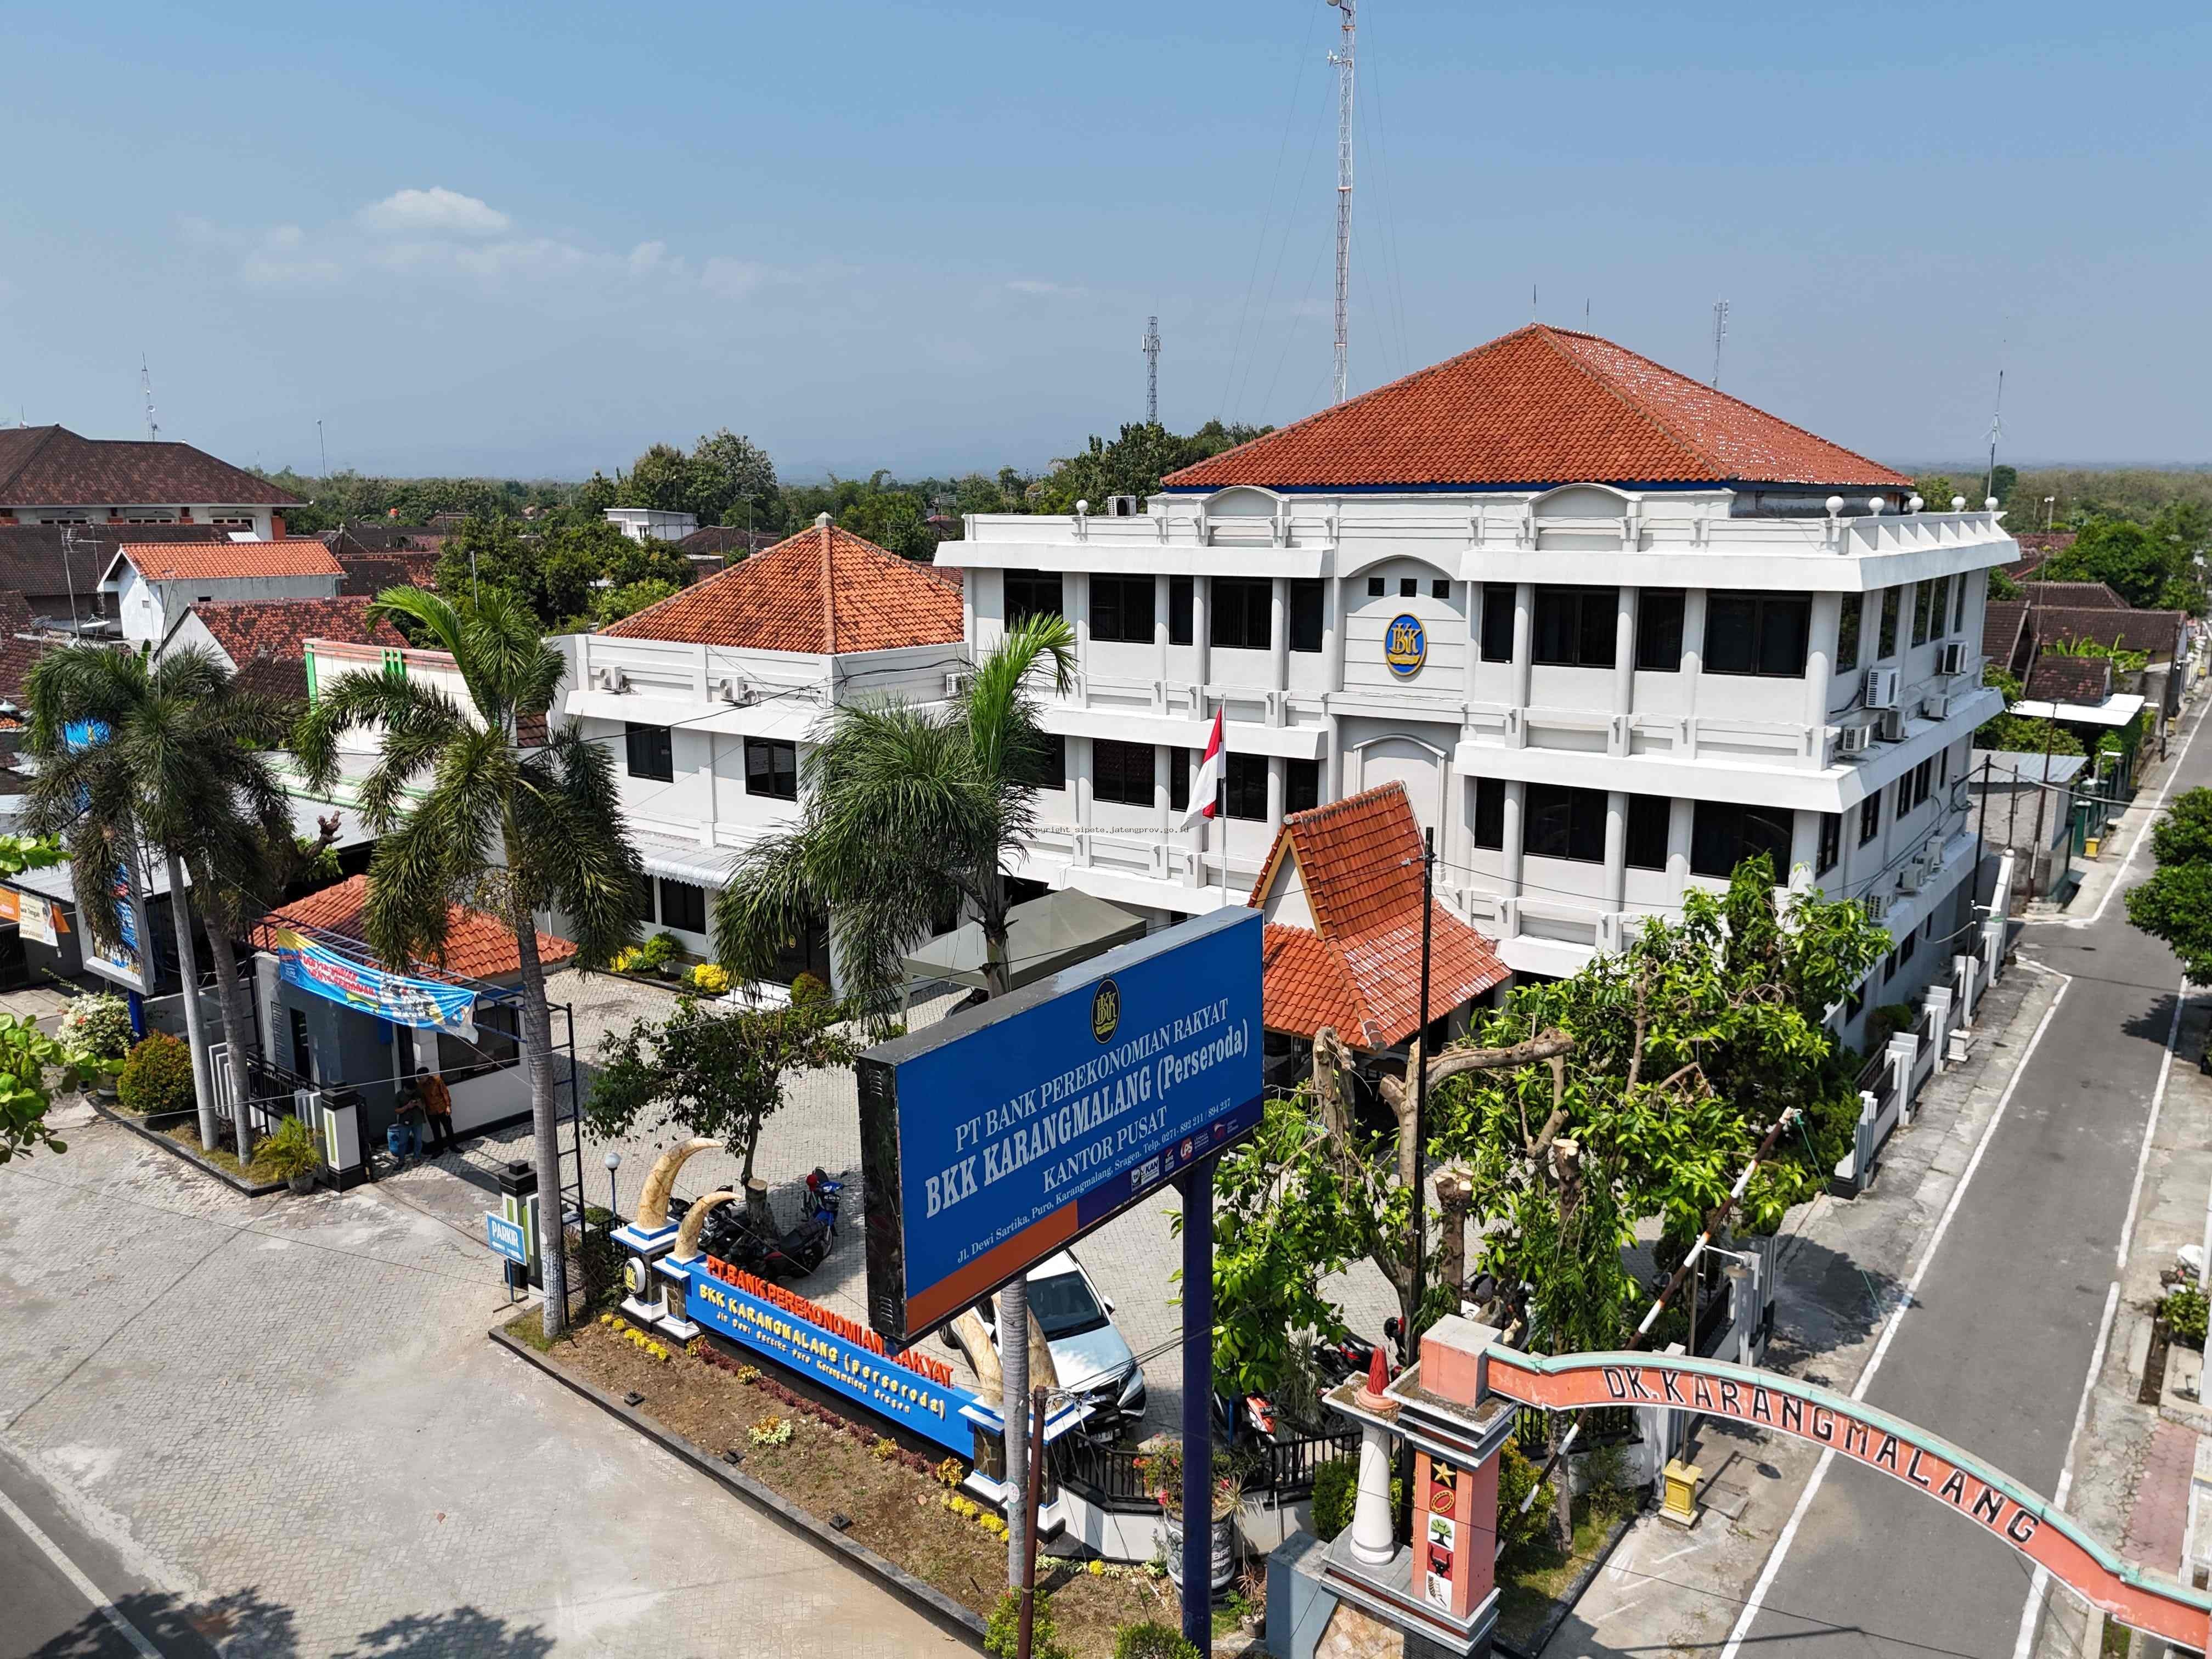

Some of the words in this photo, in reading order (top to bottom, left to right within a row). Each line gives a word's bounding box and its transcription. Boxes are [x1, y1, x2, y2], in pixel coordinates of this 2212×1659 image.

[955, 1116, 981, 1153] PT
[985, 1088, 1037, 1137] BANK
[1040, 1024, 1171, 1109] PEREKONOMIAN
[1173, 997, 1228, 1043] RAKYAT
[925, 1155, 978, 1218] BKK
[983, 1064, 1152, 1187] KARANGMALANG
[1157, 1018, 1248, 1100] (Perseroda)
[1042, 1135, 1114, 1194] KANTOR
[1116, 1105, 1167, 1152] PUSAT
[957, 1250, 969, 1263] Jl.
[971, 1233, 994, 1256] Dewi
[1031, 1201, 1054, 1219] Puro,
[1056, 1166, 1113, 1206] Karangmalang,
[1143, 1139, 1160, 1155] Telp.
[1180, 1118, 1192, 1133] 892
[1193, 1113, 1204, 1126] 211
[1208, 1105, 1219, 1118] 894
[1220, 1097, 1231, 1111] 237
[491, 1220, 519, 1248] PARKIR
[699, 1284, 725, 1308] BKK
[728, 1297, 839, 1363] KARANGMALANG
[768, 1283, 885, 1357] PEREKONOMIAN
[792, 1348, 810, 1364] Puro
[816, 1359, 868, 1393] Karangmalang
